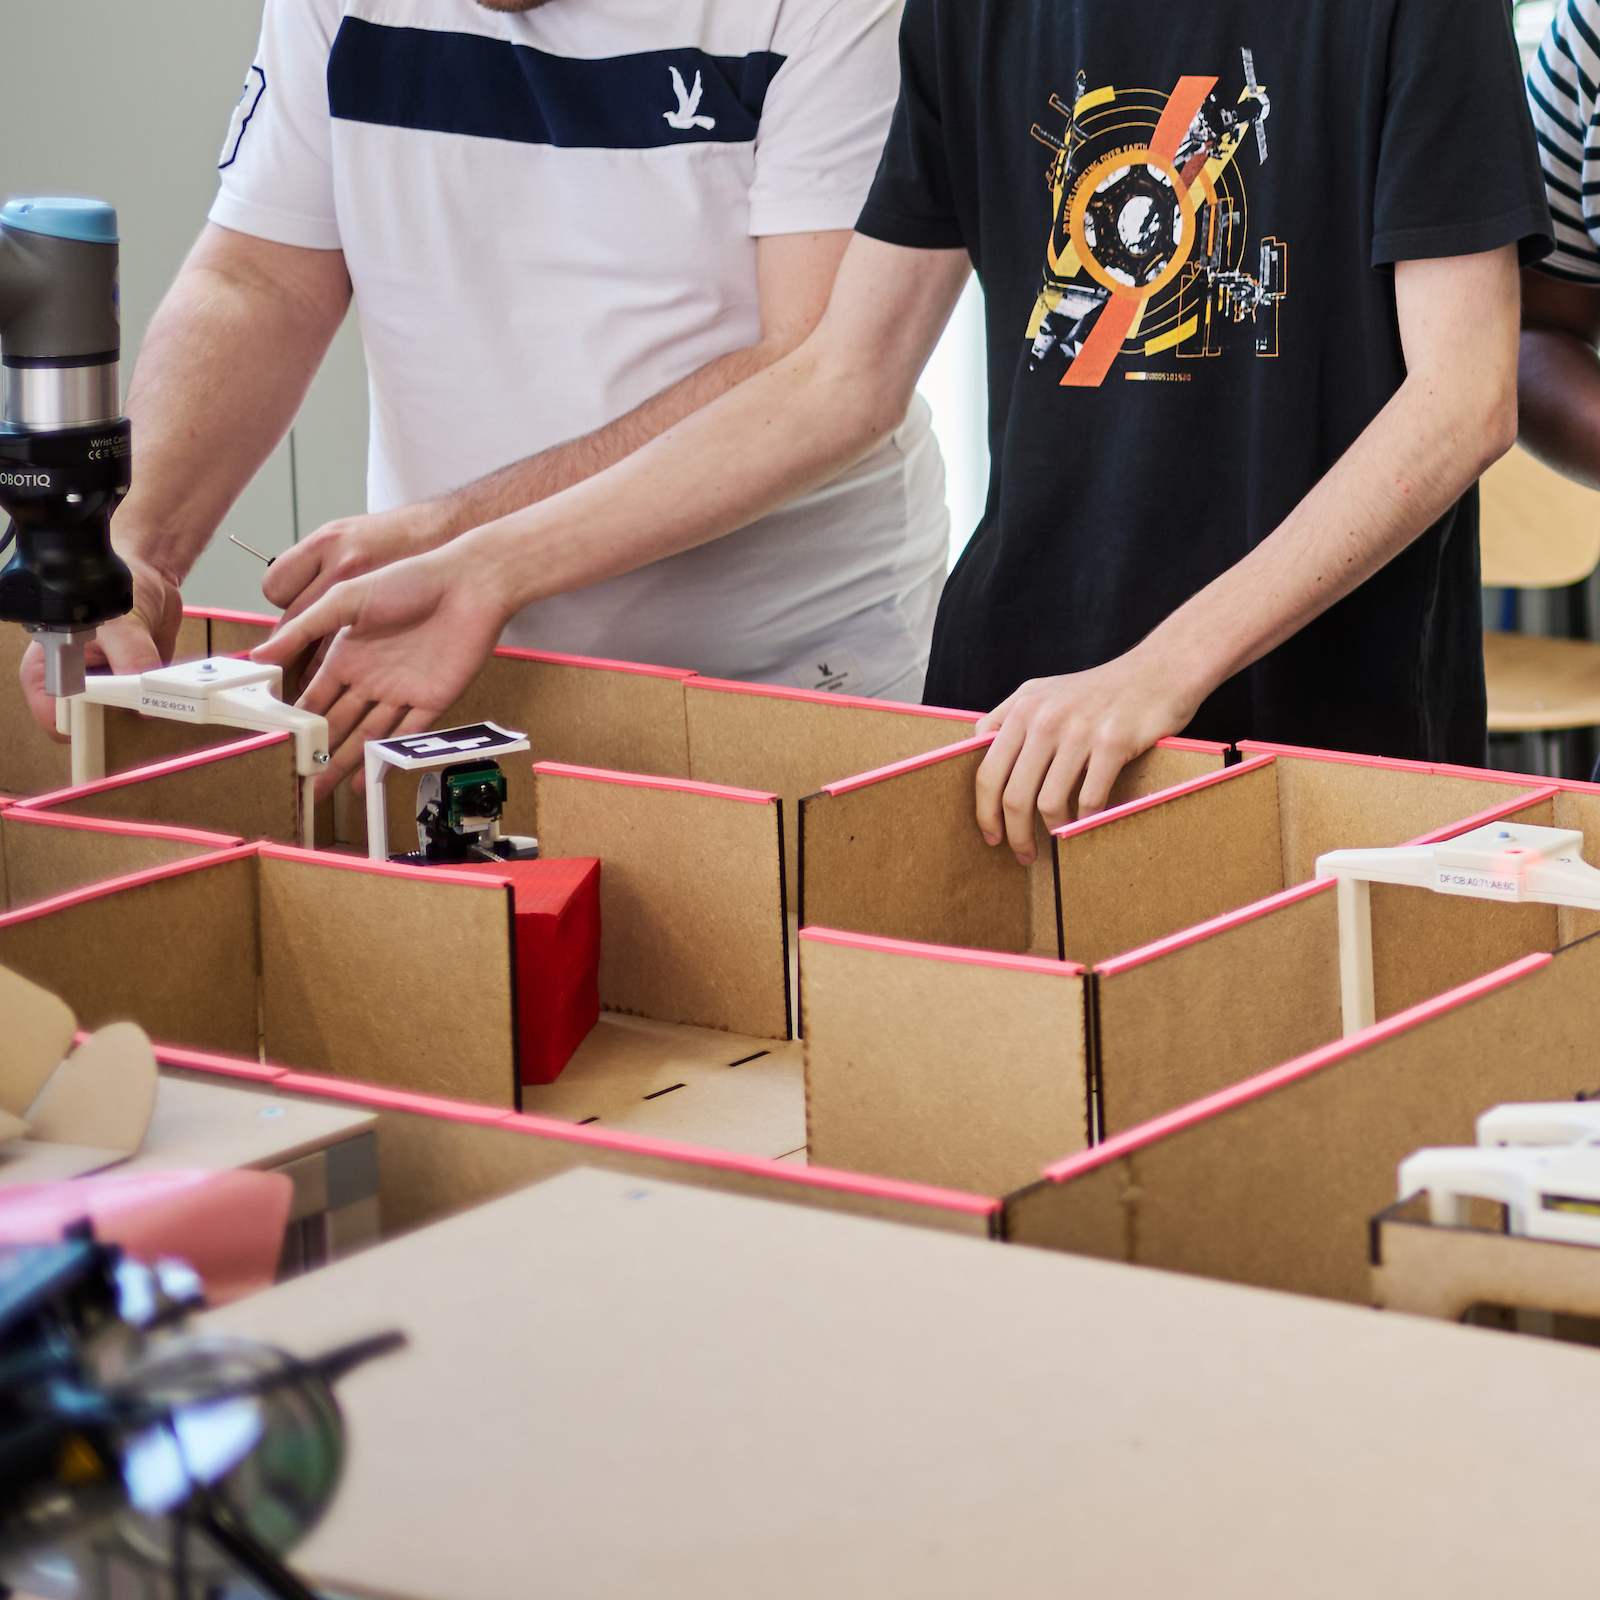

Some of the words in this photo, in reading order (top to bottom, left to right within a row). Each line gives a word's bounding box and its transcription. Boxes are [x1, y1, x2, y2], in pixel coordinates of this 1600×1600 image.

[1063, 193, 1077, 221] YEARS
[1071, 160, 1101, 193] LOOKING
[1099, 147, 1122, 164] OVER
[1122, 142, 1148, 154] EARTH
[90, 438, 113, 448] Wrist
